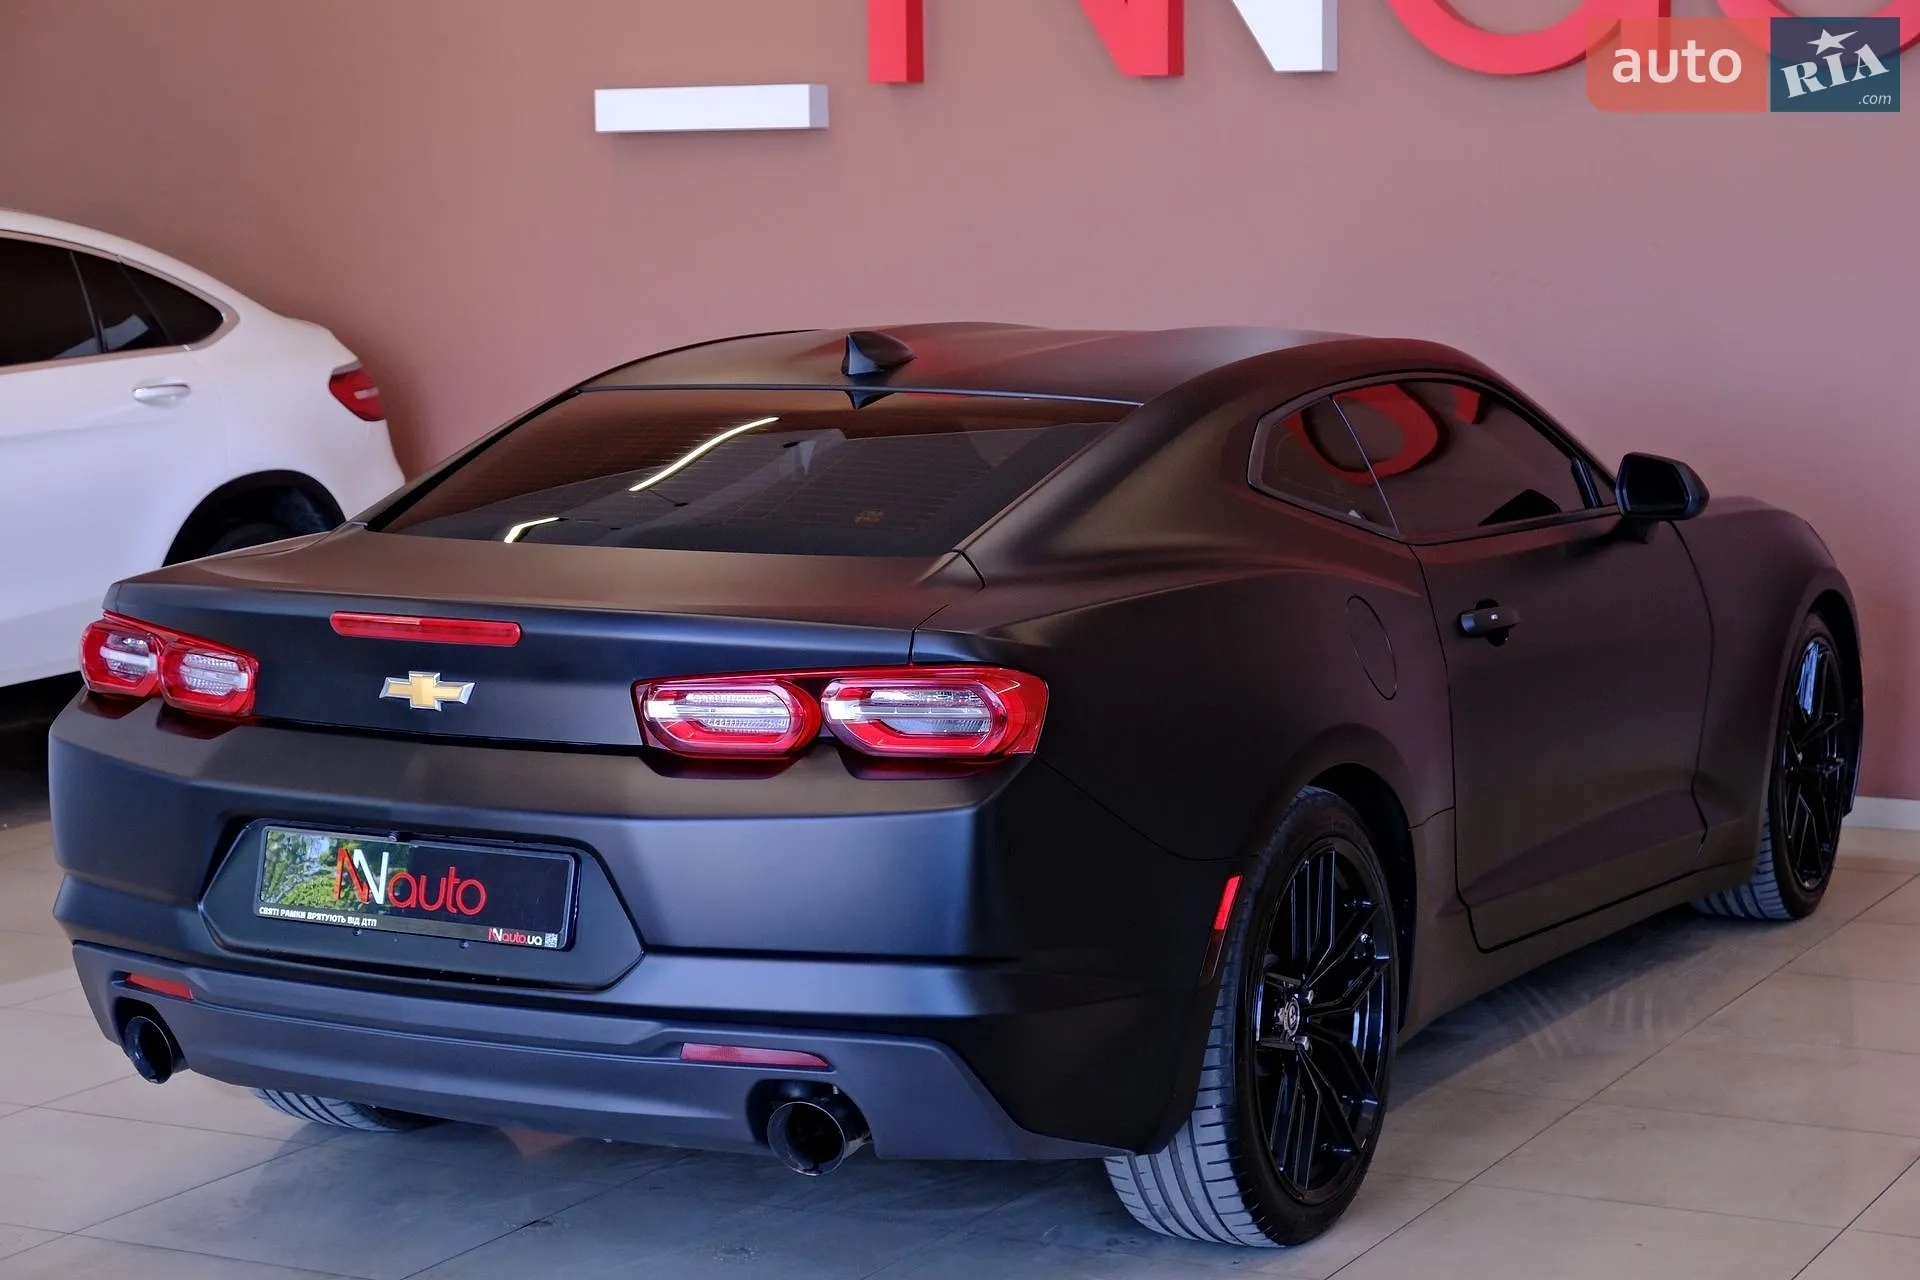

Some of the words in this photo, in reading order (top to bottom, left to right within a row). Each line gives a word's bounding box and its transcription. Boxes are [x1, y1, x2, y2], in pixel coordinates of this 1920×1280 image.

[259, 906, 280, 916] СВЯТІ
[280, 908, 306, 919] РАМКИ
[307, 911, 347, 924] ВРЯТУЮТЬ
[361, 917, 378, 927] ДТП
